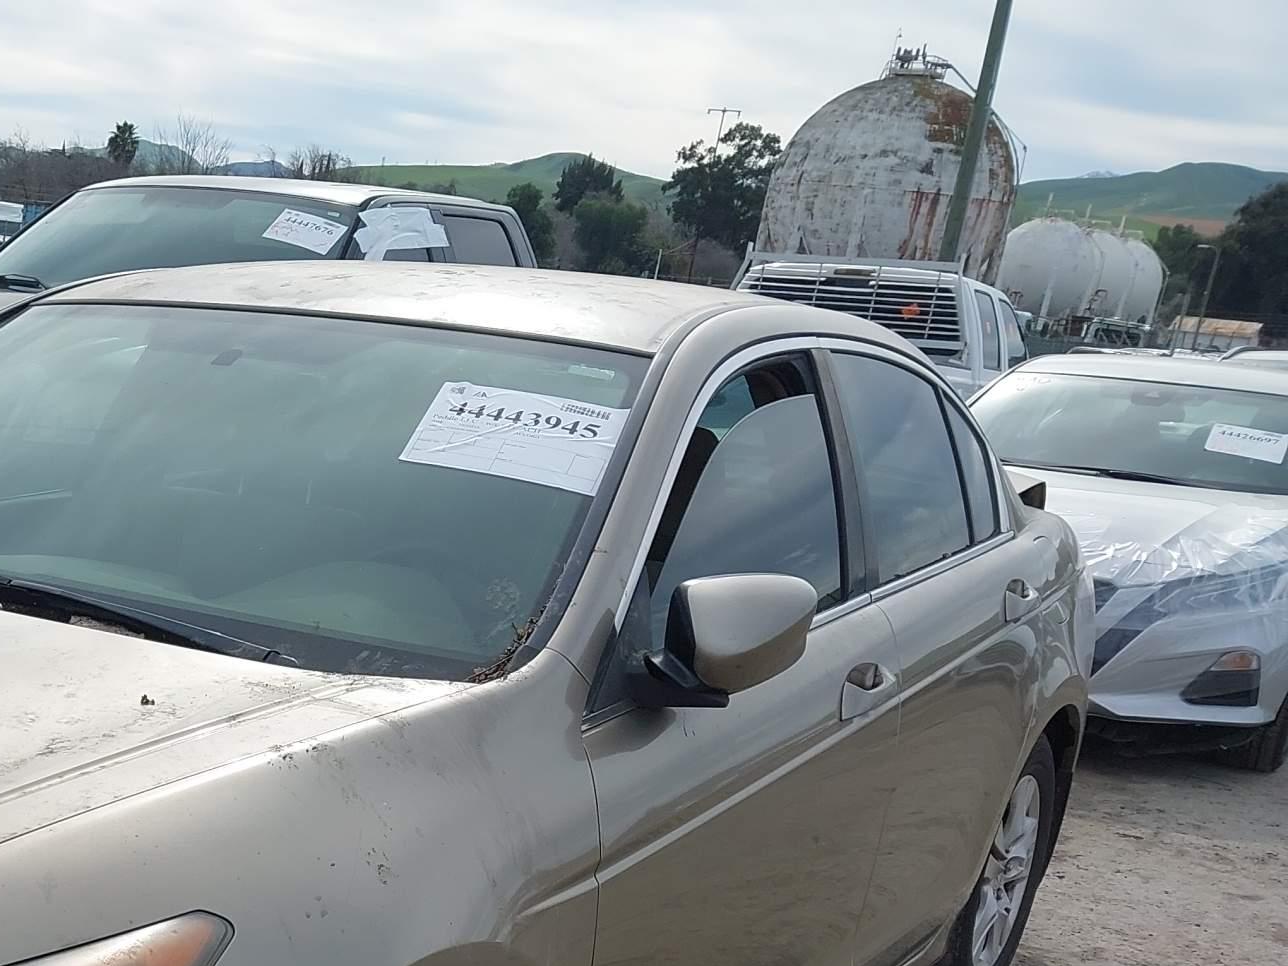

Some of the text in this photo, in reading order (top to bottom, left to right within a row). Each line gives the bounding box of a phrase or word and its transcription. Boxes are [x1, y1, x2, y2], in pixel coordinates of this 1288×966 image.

[285, 217, 334, 235] 44447676
[449, 402, 601, 438] 44443945
[1219, 431, 1280, 444] 44426697
